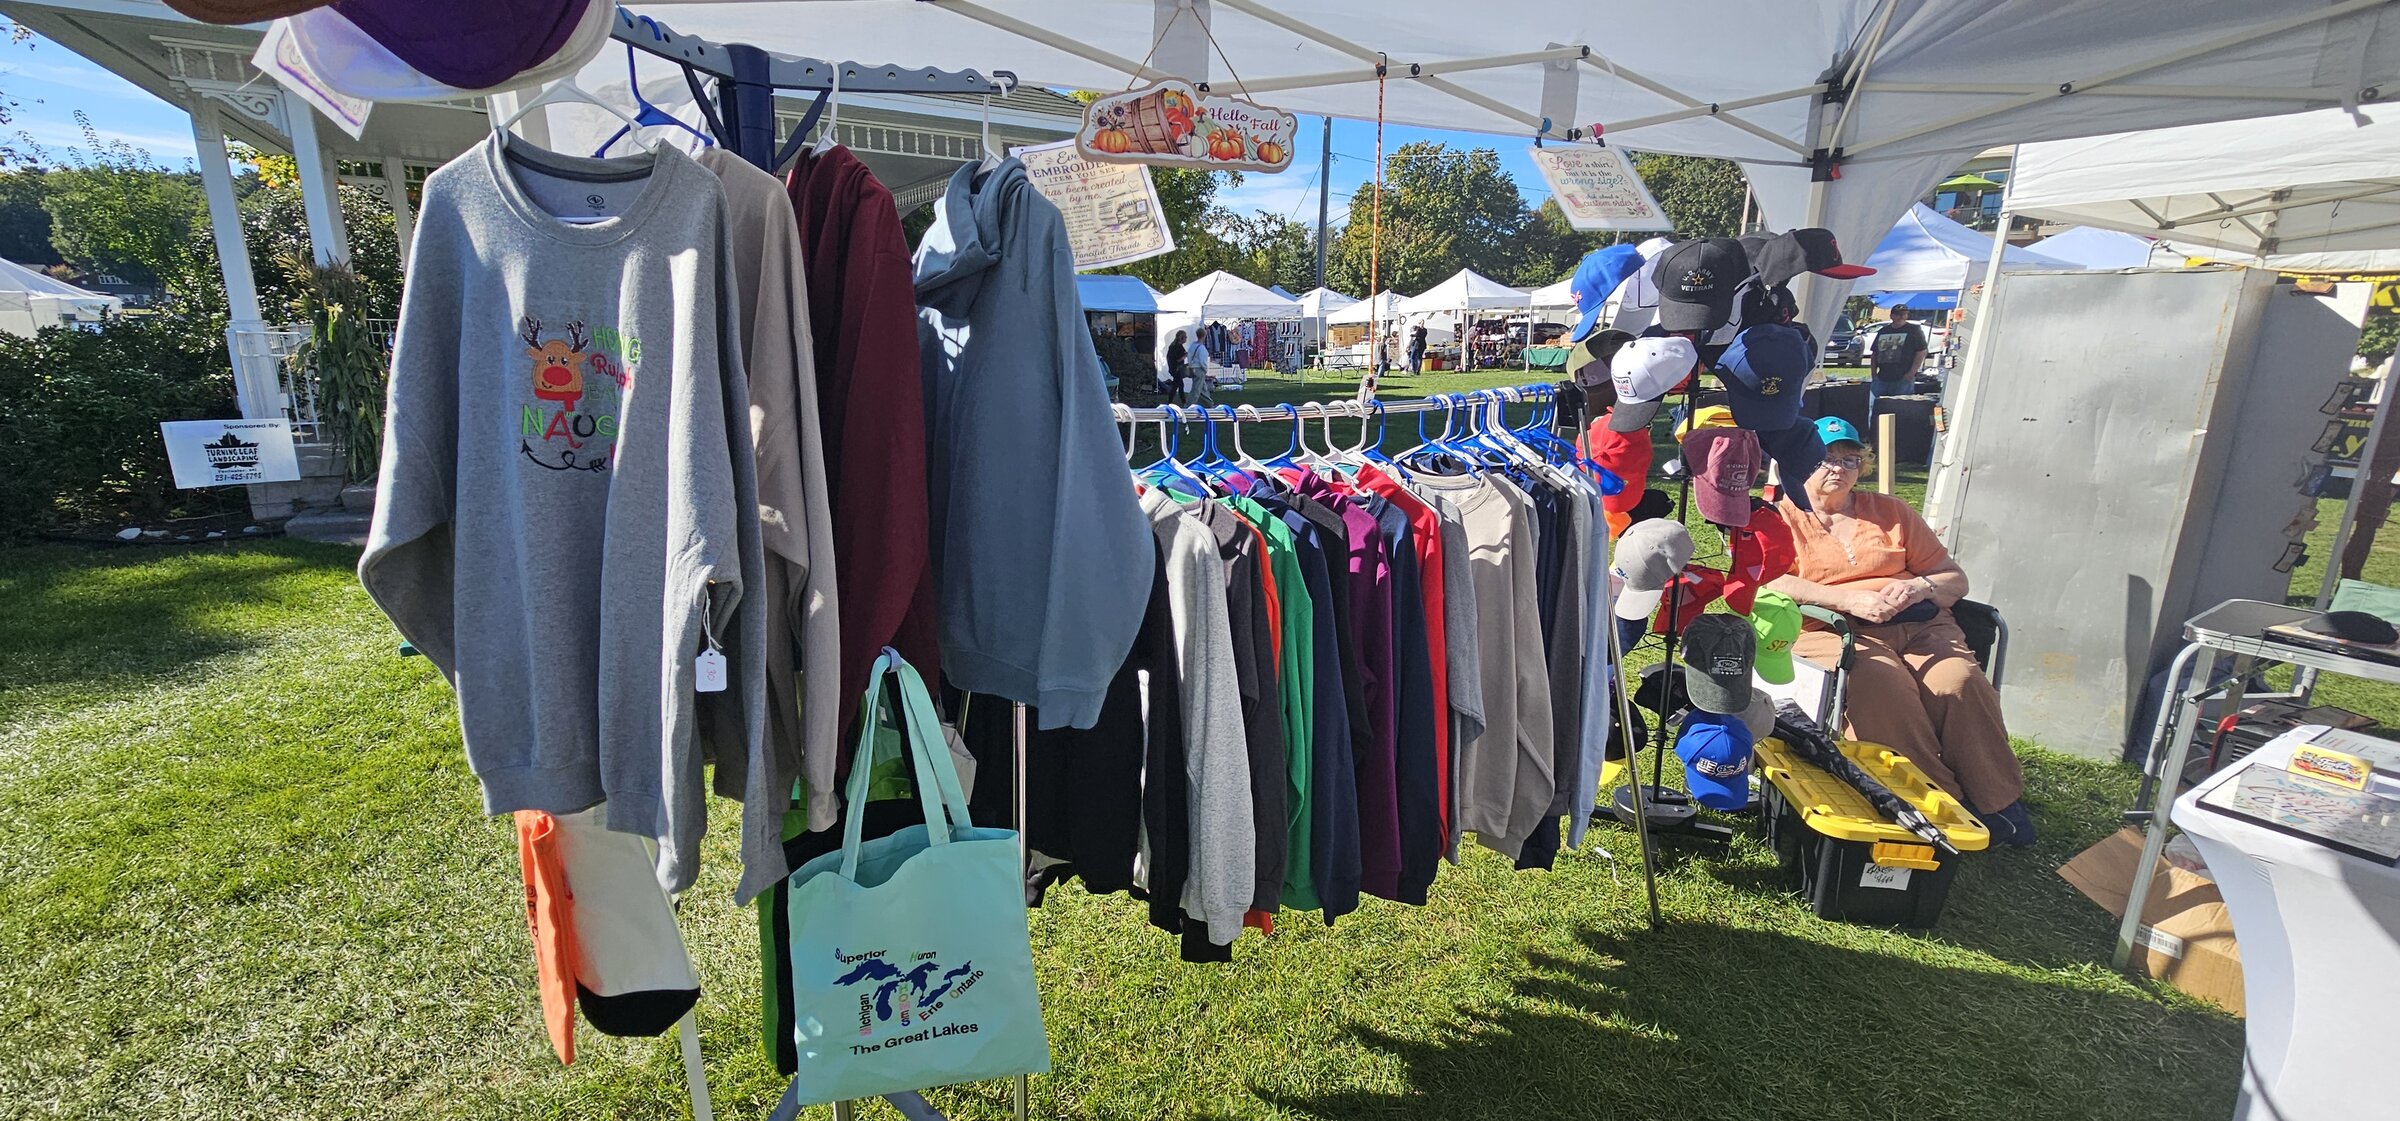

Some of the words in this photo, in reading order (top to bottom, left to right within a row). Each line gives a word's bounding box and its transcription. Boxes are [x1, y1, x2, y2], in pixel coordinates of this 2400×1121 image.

[1209, 107, 1249, 121] Hello
[1250, 118, 1281, 131] Fall
[1549, 156, 1583, 170] Love
[1049, 175, 1072, 183] ITEM
[1076, 171, 1094, 180] YOU
[1099, 166, 1117, 175] SEE
[1044, 186, 1062, 198] has
[1066, 184, 1089, 195] been
[1091, 174, 1128, 191] created
[1560, 177, 1596, 188] wrong
[1597, 175, 1624, 188] size?
[1069, 194, 1082, 204] by
[1612, 199, 1634, 207] order
[1108, 241, 1141, 253] Threads
[1681, 283, 1714, 292] VETERAN
[206, 448, 238, 456] TURNING
[239, 447, 259, 455] LEAF
[208, 455, 259, 463] LANDSCAPING
[835, 947, 887, 965] Superior
[910, 951, 937, 963] Huron
[949, 969, 985, 1000] Ontario
[859, 993, 873, 1037] Michigan
[919, 1000, 944, 1022] Erie
[849, 1044, 881, 1056] The
[884, 1029, 930, 1049] Great
[933, 1022, 979, 1038] Lakes
